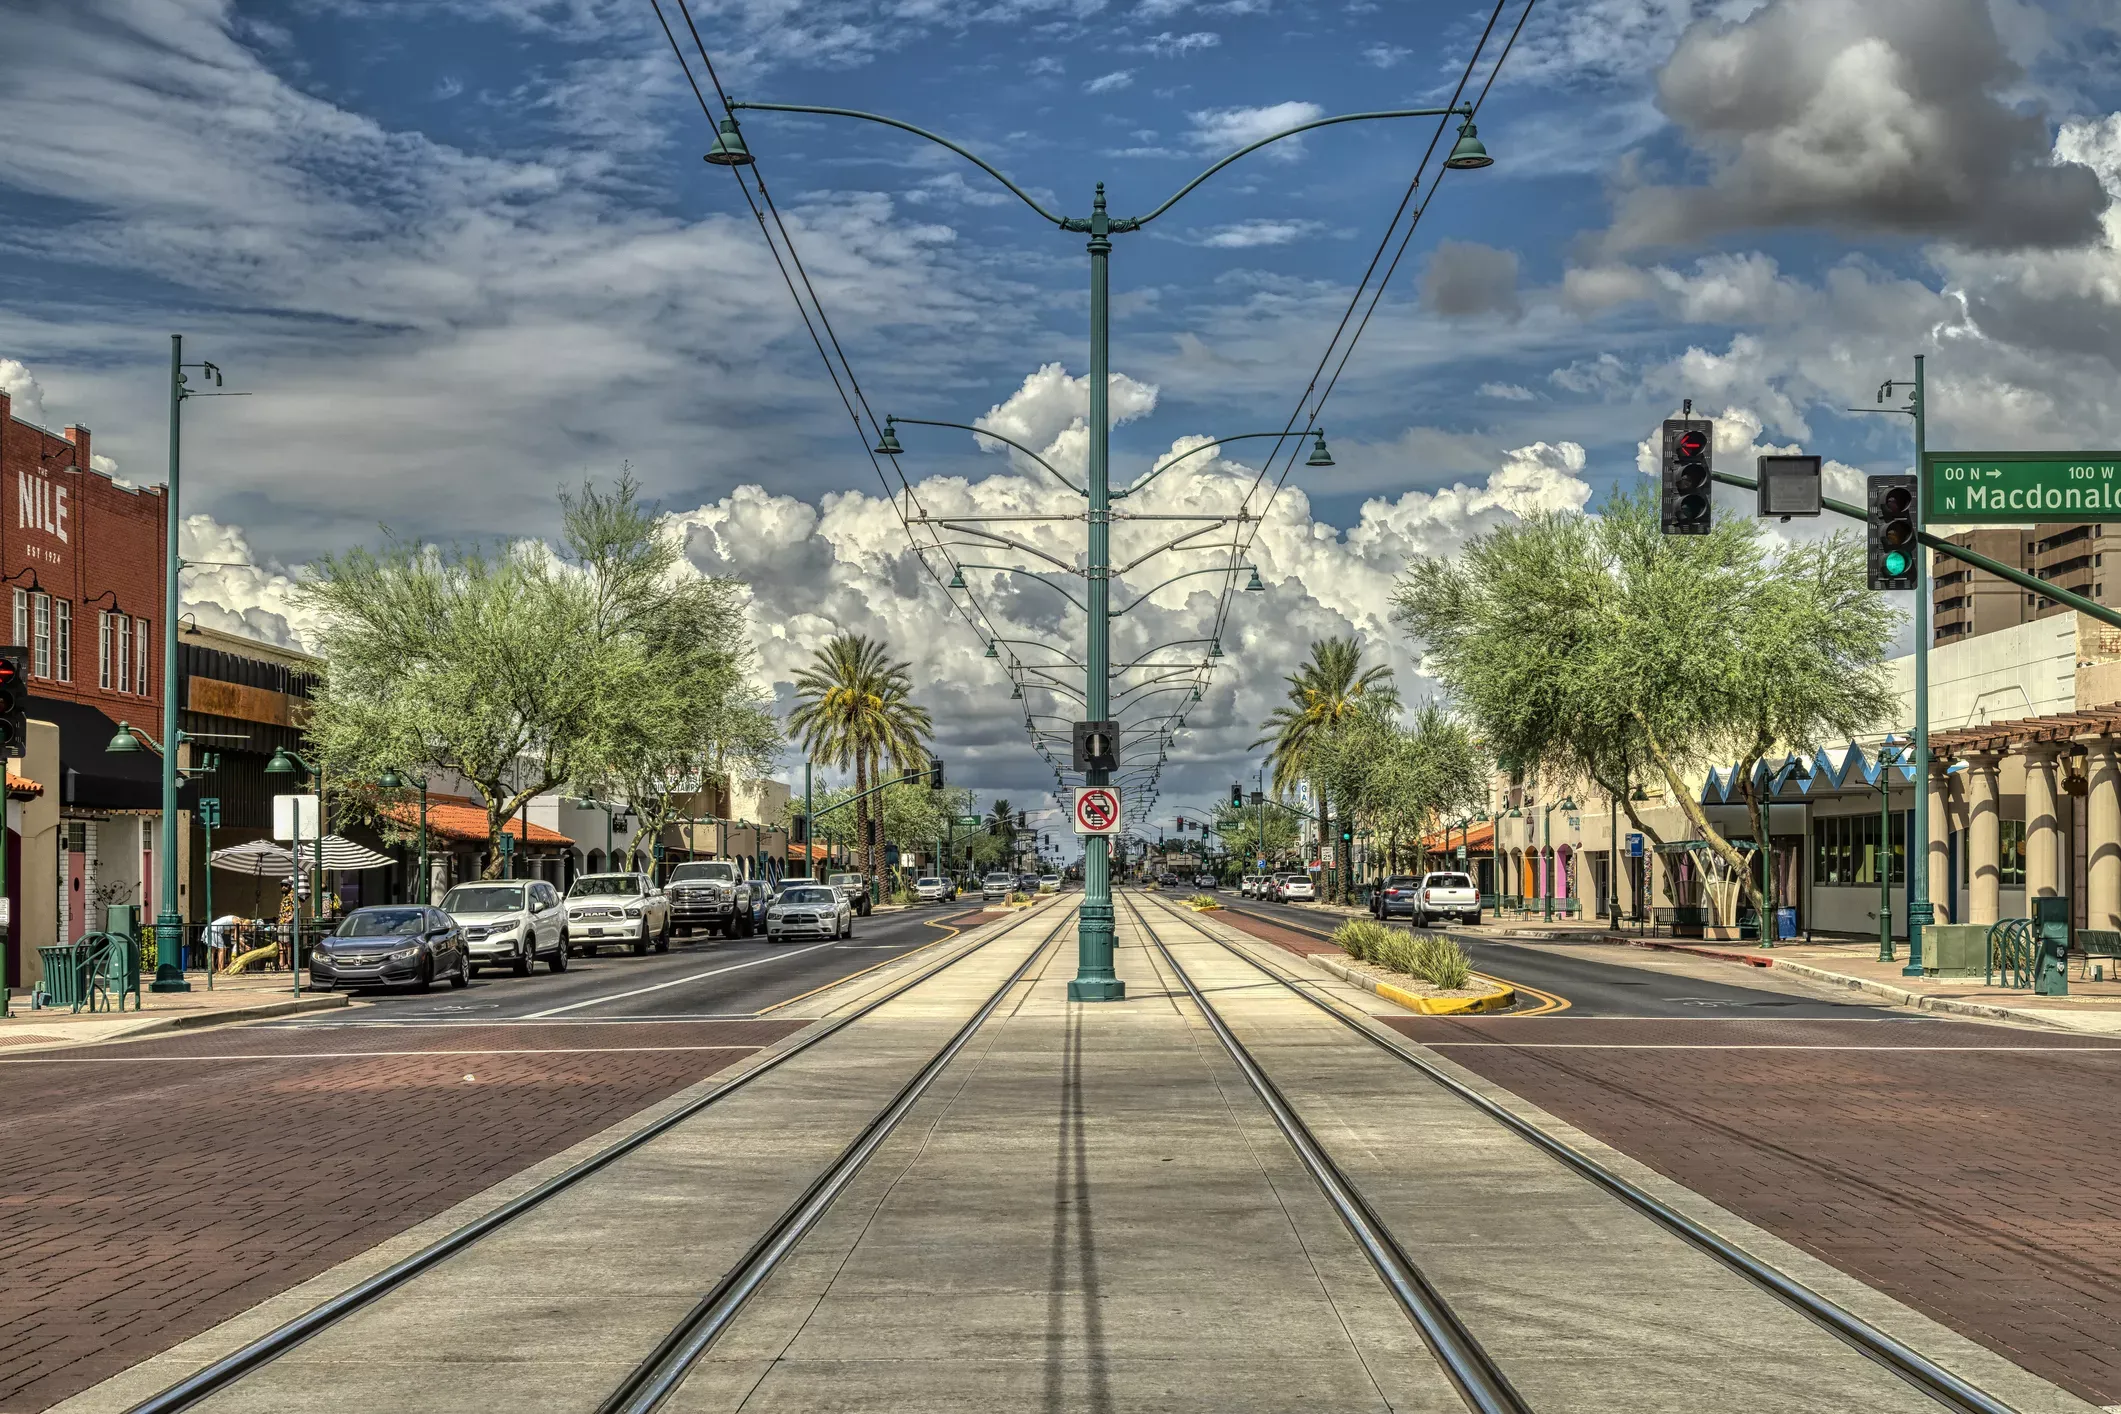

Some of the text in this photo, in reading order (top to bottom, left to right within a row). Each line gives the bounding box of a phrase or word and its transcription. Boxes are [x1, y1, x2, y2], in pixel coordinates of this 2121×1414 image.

[37, 466, 48, 478] THE
[1945, 467, 1980, 480] 00 N
[2068, 466, 2114, 480] 100 W
[18, 470, 68, 544] NILE
[1946, 497, 1956, 510] N
[26, 544, 61, 565] EST 1924
